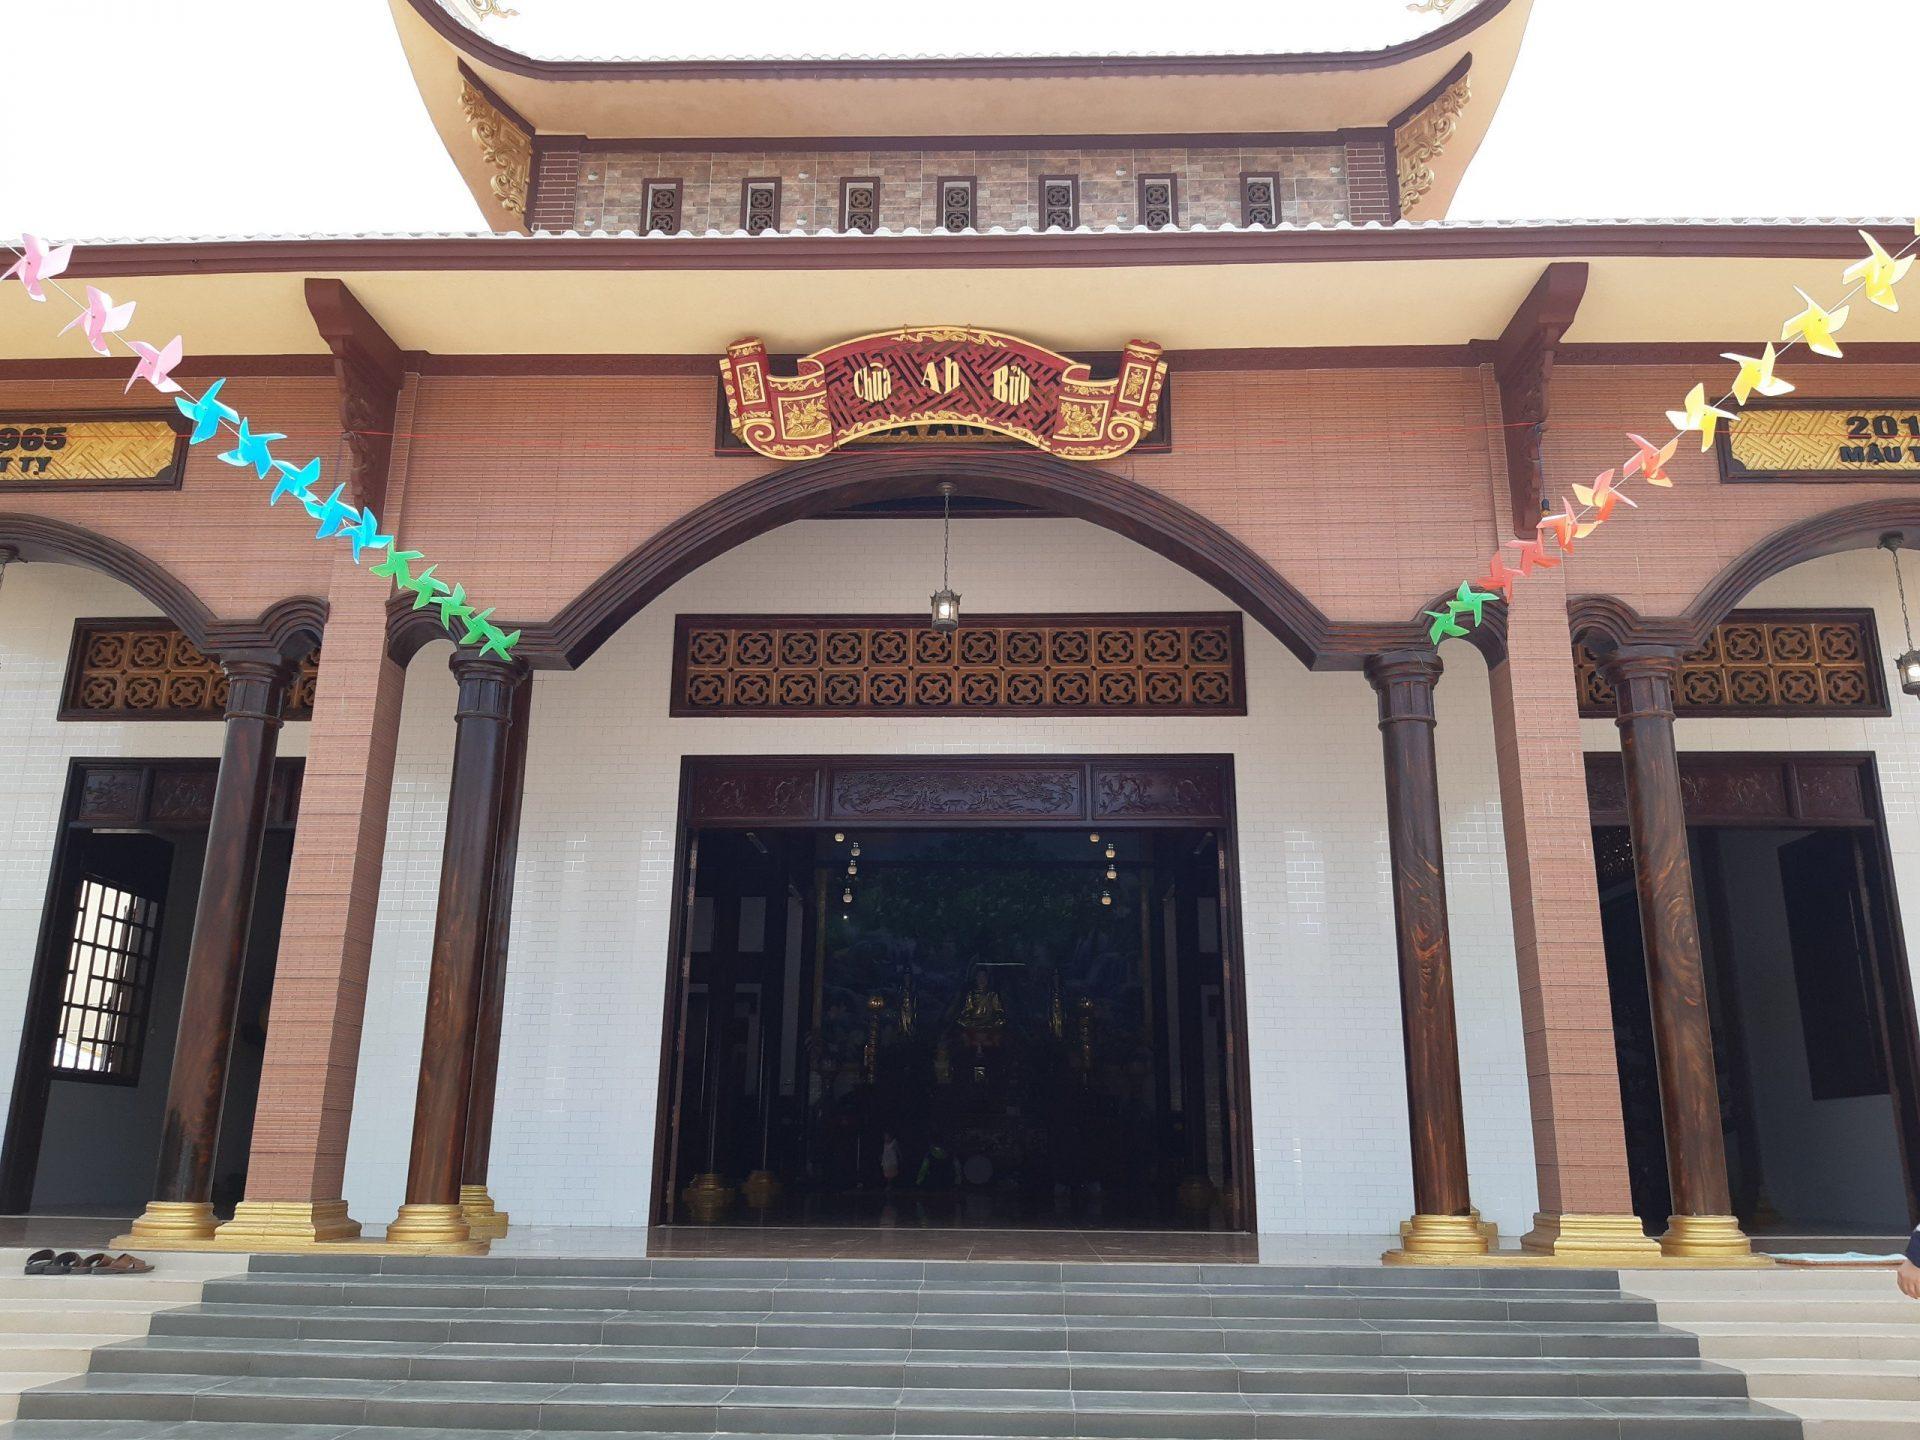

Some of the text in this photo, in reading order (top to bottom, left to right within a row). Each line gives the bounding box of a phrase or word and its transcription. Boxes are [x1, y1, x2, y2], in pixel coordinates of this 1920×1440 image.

[854, 362, 892, 403] Chùa
[921, 356, 961, 394] An
[1839, 442, 1903, 466] MẬU
